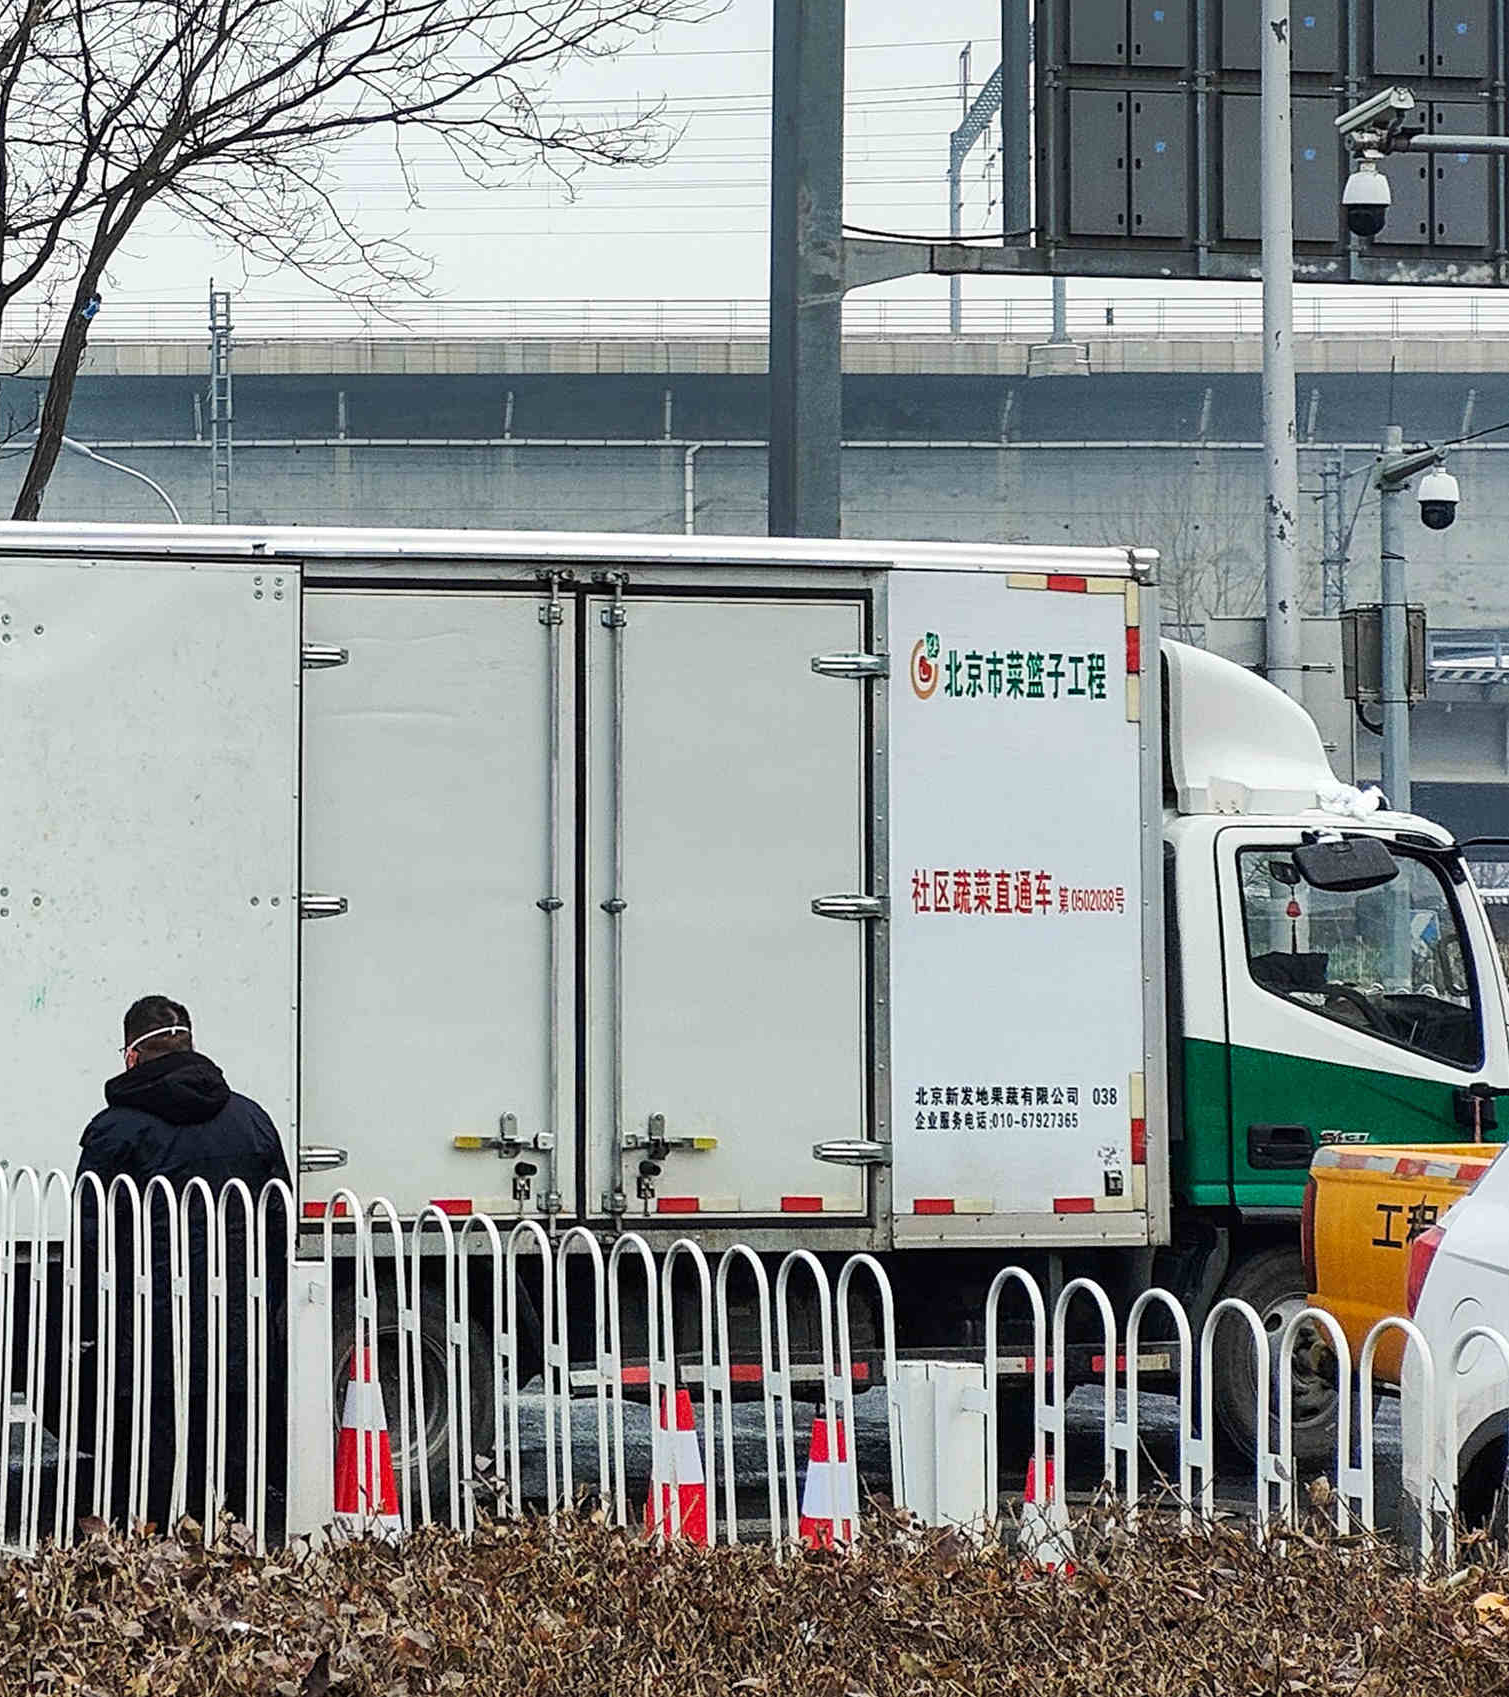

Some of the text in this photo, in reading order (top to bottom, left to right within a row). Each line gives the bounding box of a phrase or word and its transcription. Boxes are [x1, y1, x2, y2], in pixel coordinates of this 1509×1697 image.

[944, 649, 1107, 700] 北京市菜篮子工程
[911, 868, 1053, 915] 社区蔬菜直通车
[915, 1086, 1118, 1106] 北京新发地果蔬有限公司 038
